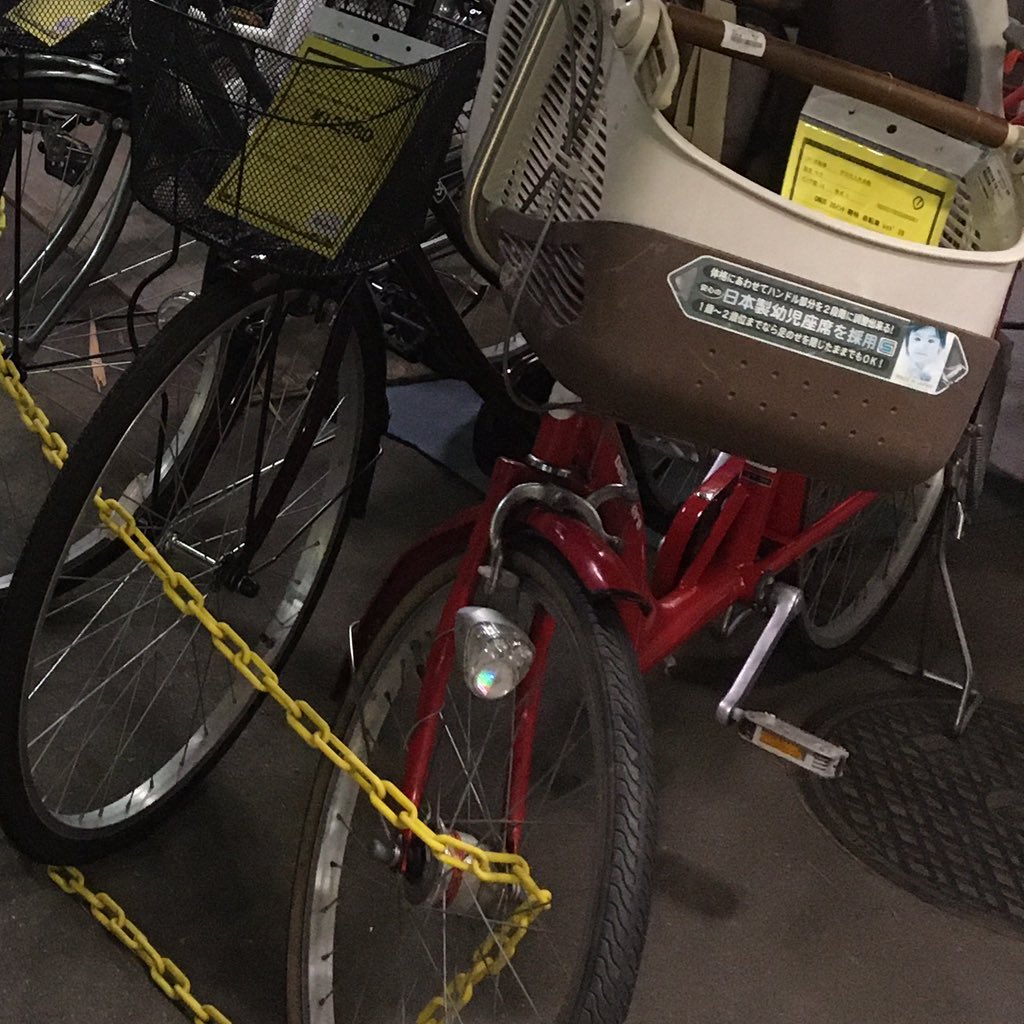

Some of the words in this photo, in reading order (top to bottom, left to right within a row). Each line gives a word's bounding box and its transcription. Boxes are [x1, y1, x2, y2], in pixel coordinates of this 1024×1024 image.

[723, 288, 878, 351] 日本製幼児座席を採用
